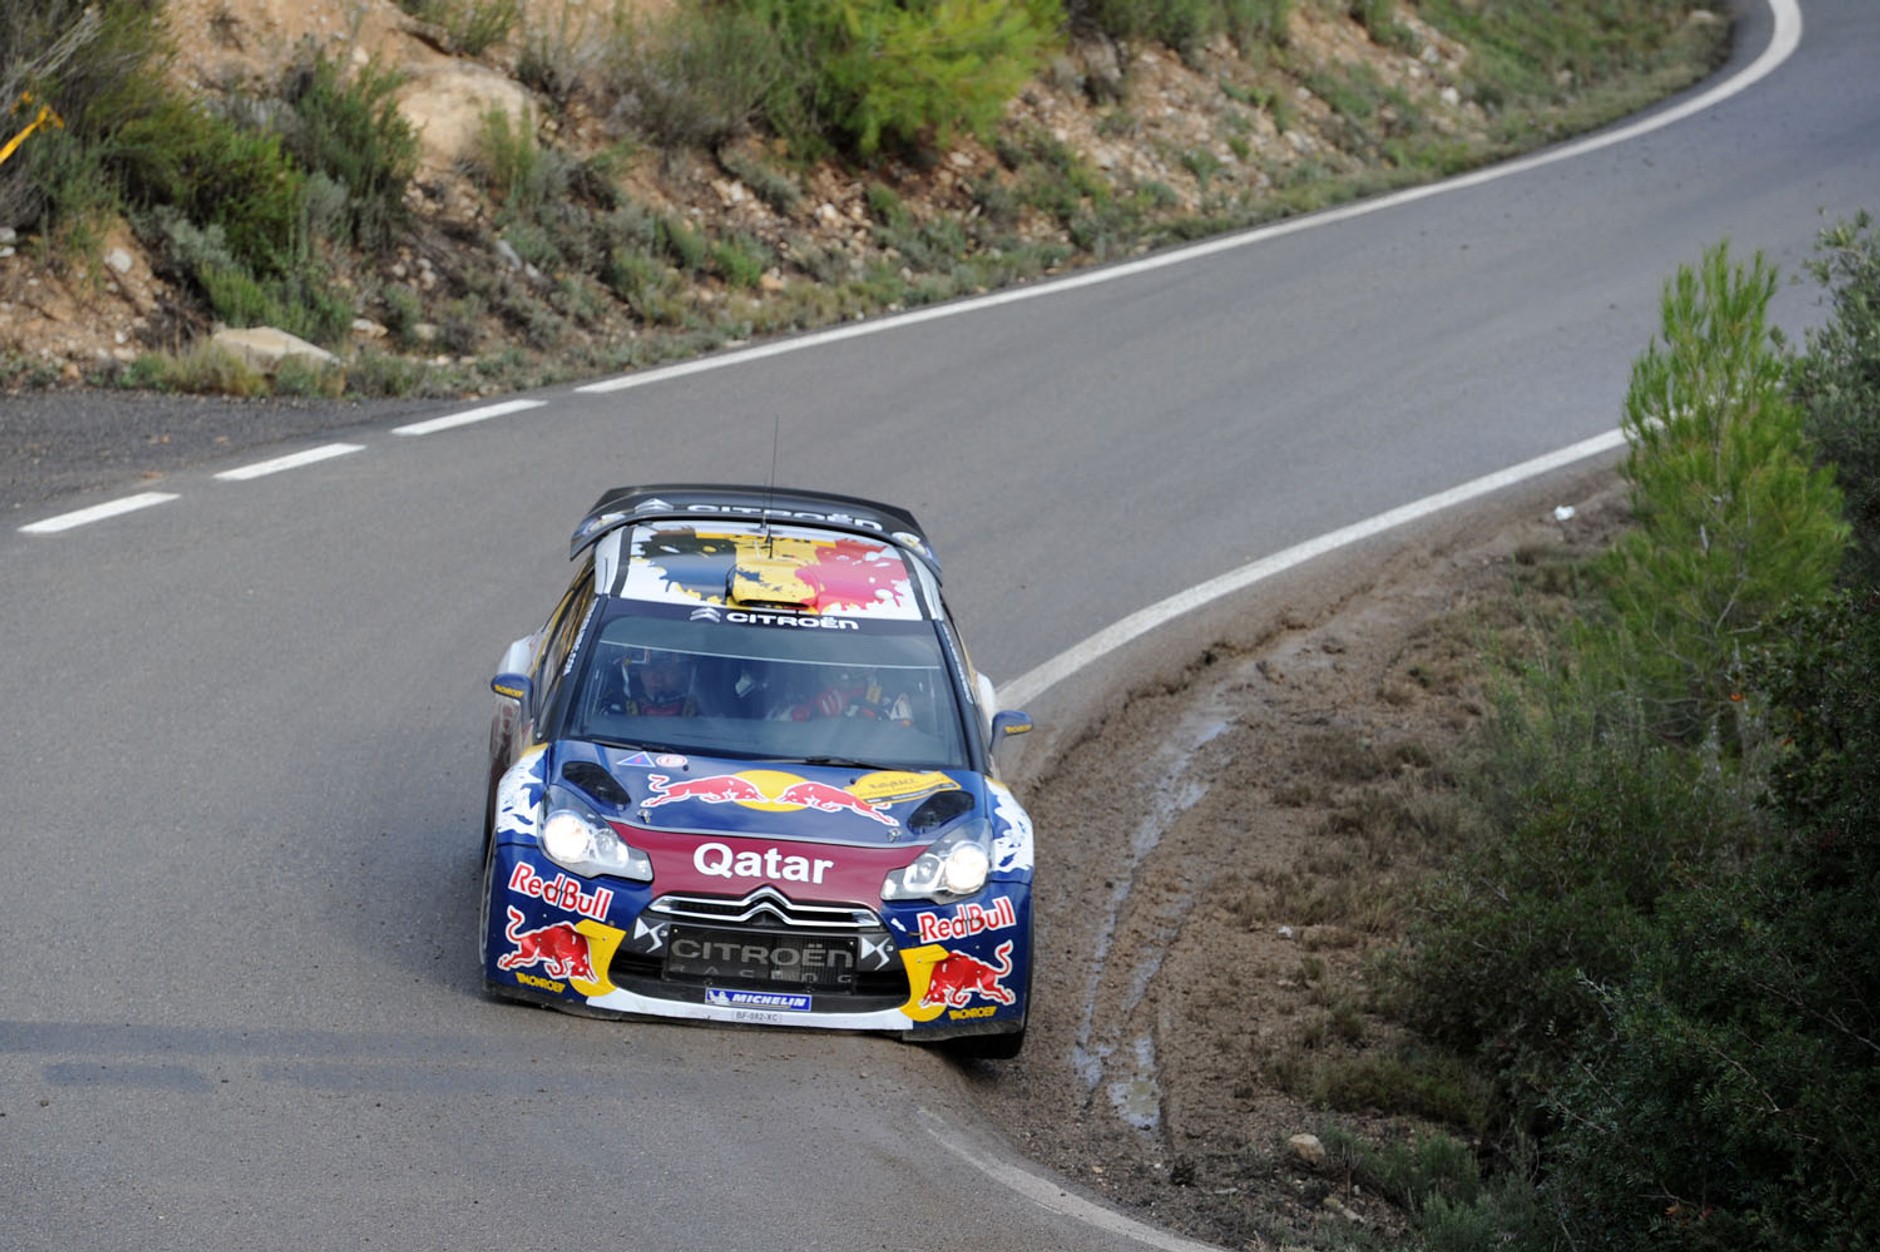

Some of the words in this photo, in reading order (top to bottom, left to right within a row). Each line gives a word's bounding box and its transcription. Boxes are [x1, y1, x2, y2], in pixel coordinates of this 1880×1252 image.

[726, 612, 859, 630] CITROËN
[693, 843, 835, 884] Qatar
[671, 939, 853, 968] CITROËN
[732, 993, 807, 1007] MICHELIN
